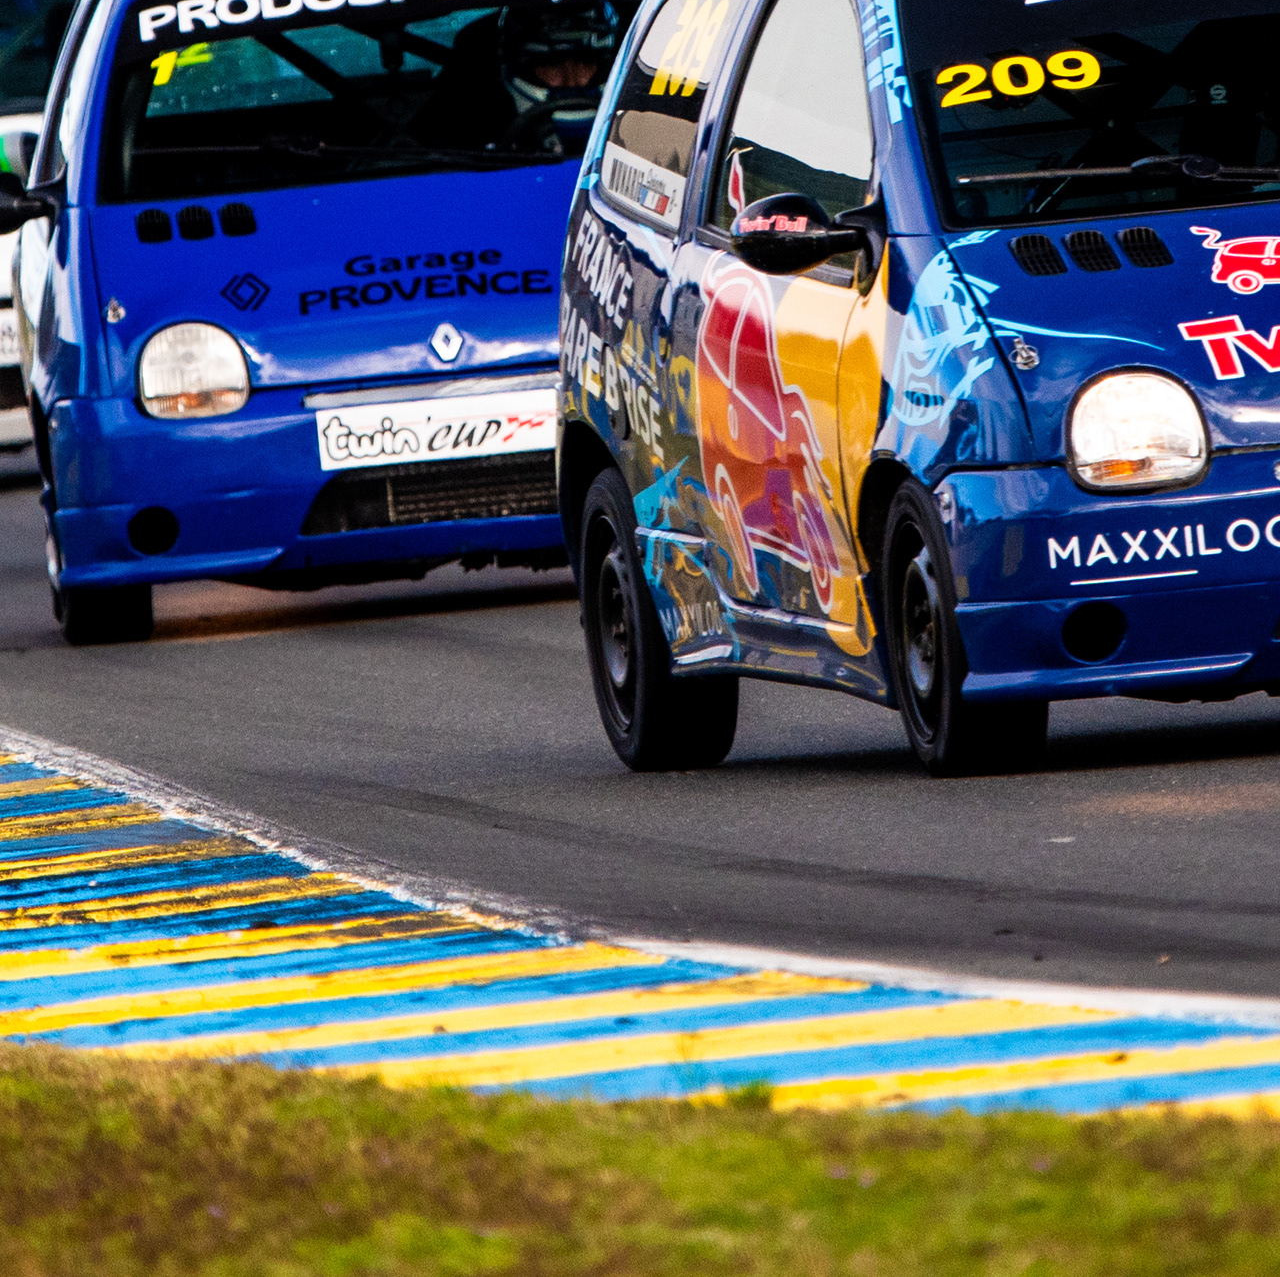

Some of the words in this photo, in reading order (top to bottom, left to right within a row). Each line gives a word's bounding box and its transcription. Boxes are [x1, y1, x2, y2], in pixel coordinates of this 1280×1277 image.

[936, 50, 1101, 108] 209
[344, 249, 503, 277] Garage
[571, 210, 634, 331] FRANCE
[298, 269, 553, 316] PROVENCE
